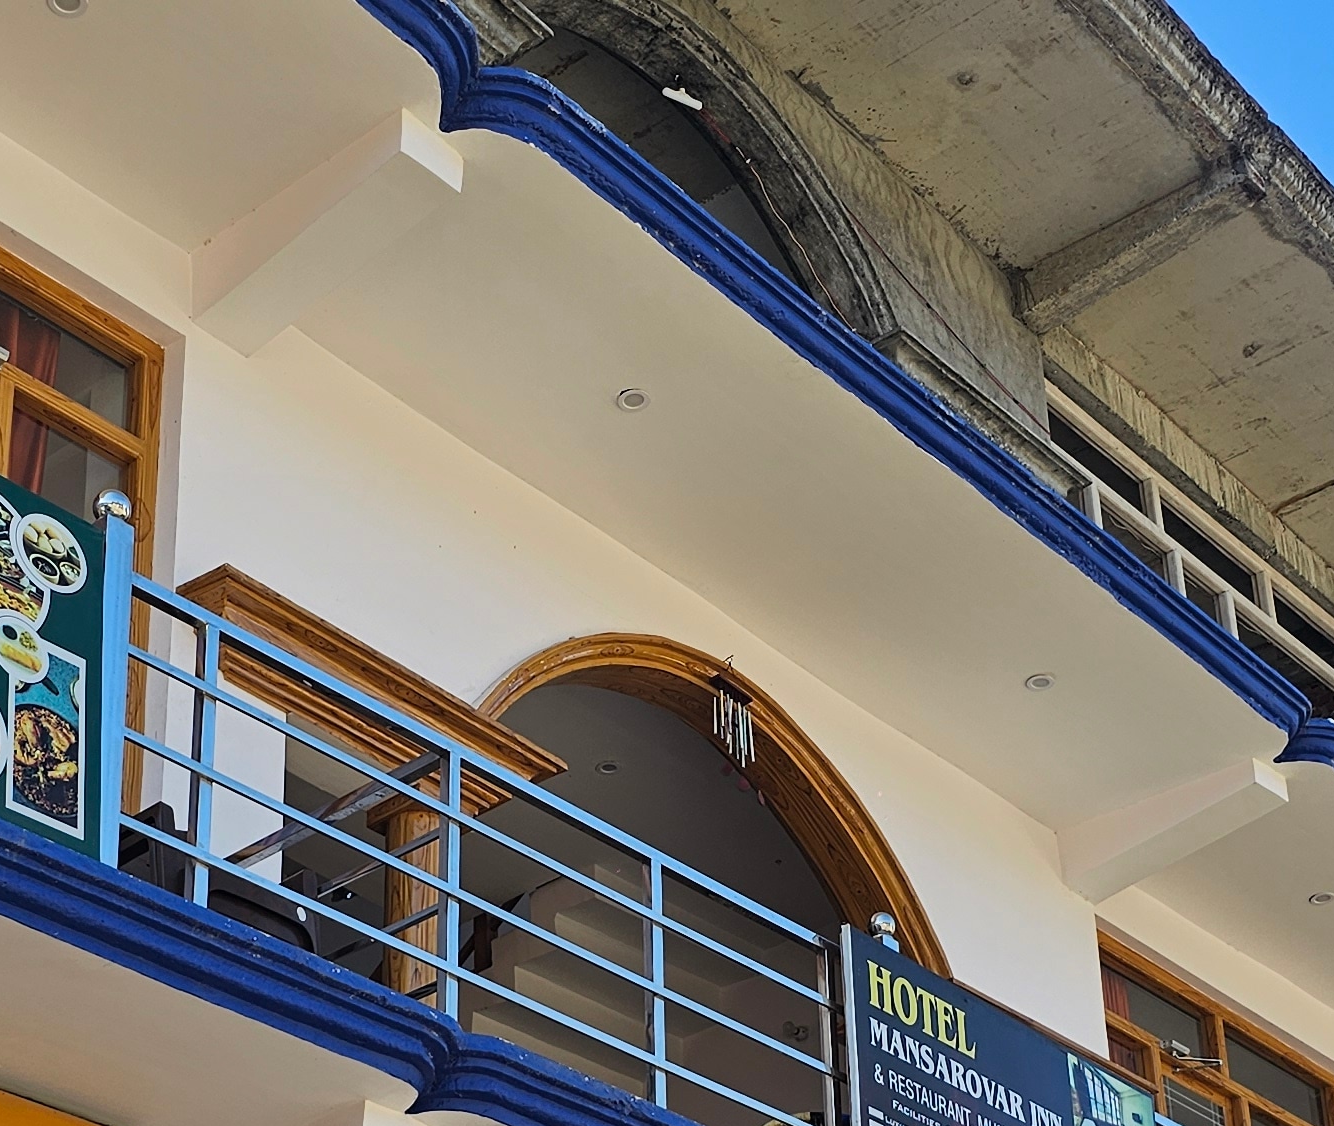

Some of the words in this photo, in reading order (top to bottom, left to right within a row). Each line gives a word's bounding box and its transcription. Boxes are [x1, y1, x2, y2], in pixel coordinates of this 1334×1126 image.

[867, 960, 976, 1059] HOTEL
[869, 1017, 1026, 1123] MANSAROVAR
[874, 1063, 885, 1085] &
